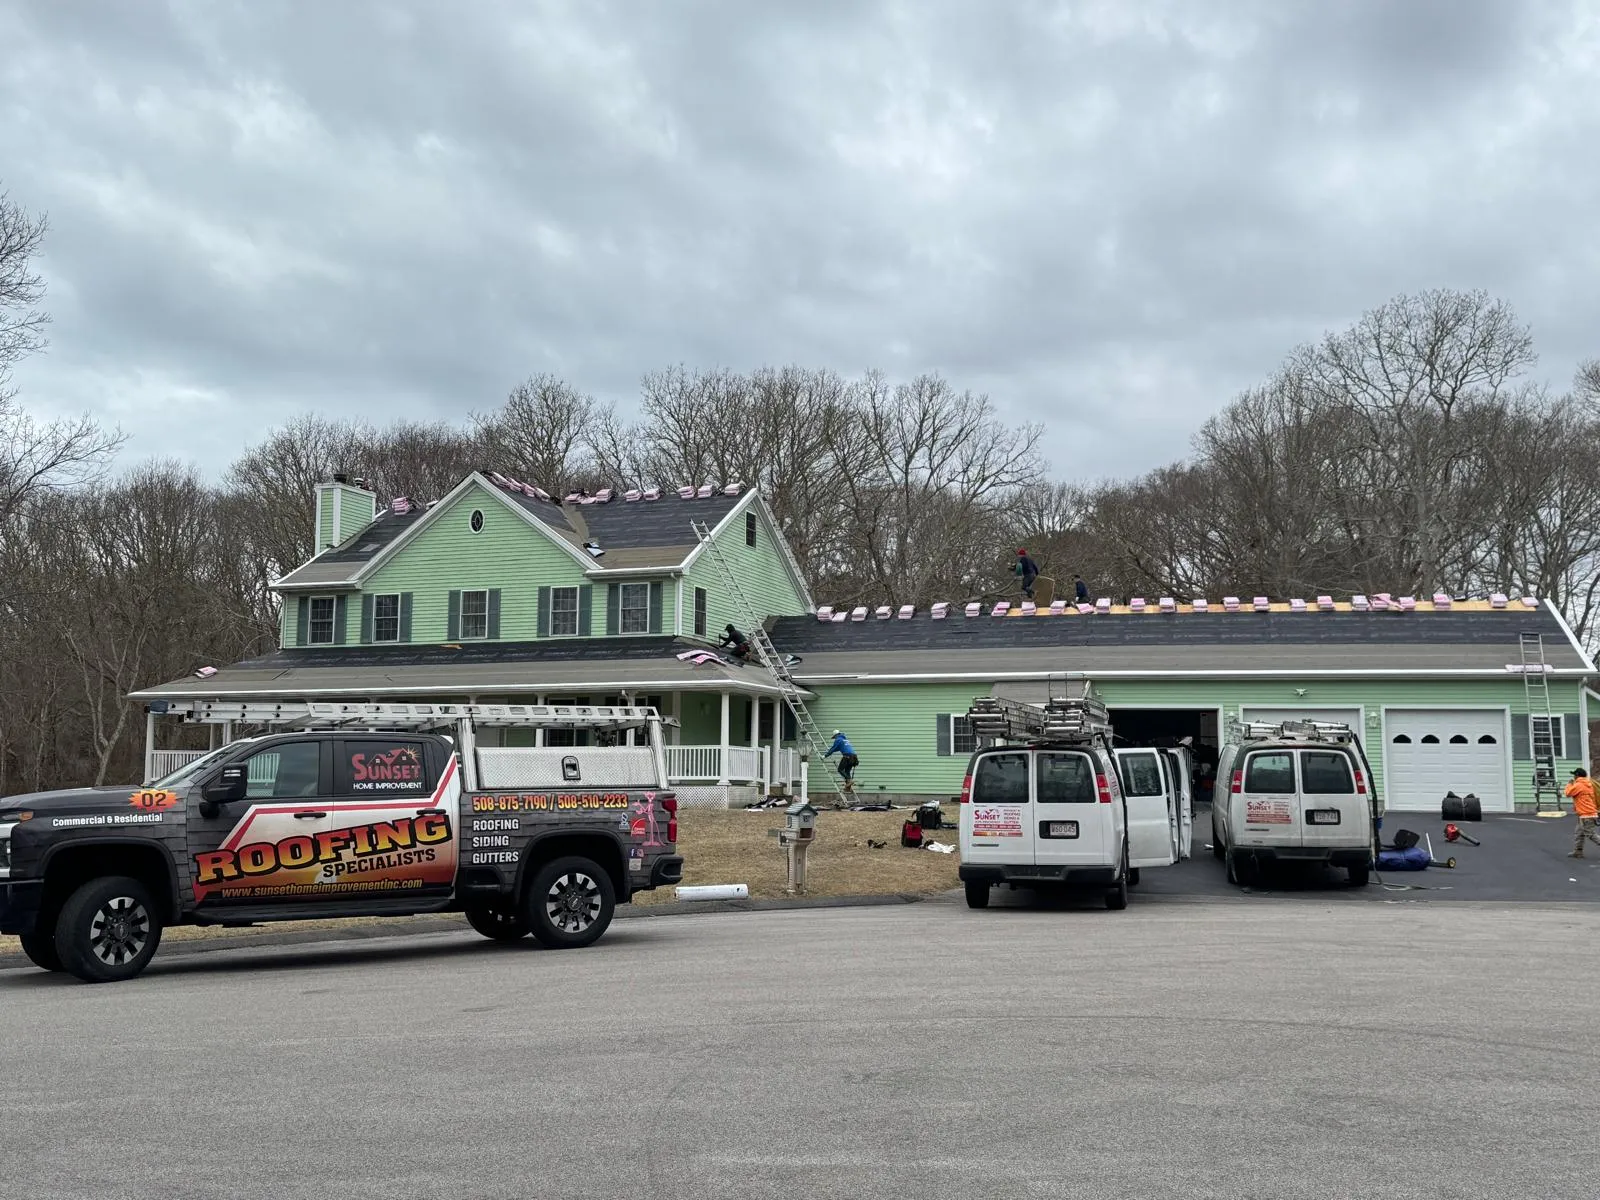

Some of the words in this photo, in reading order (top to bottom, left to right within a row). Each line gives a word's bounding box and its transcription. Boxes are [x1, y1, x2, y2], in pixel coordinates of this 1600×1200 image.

[351, 753, 421, 780] SUNSET
[353, 782, 375, 790] HOME
[375, 782, 422, 790] IMPROVEMENT
[141, 792, 167, 807] 02
[472, 795, 547, 812] 508-875-7190
[557, 793, 628, 809] 508-510-2233
[52, 815, 105, 827] Commercial
[106, 815, 113, 824] &
[114, 812, 163, 824] Residential
[473, 819, 519, 831] ROOFING
[472, 835, 509, 847] SIDING
[194, 814, 452, 884] ROOFING
[323, 849, 436, 878] SPECIALISTS
[472, 851, 519, 864] GUTTERS
[222, 878, 423, 899] www.sunsethomeimprovementinc.com
